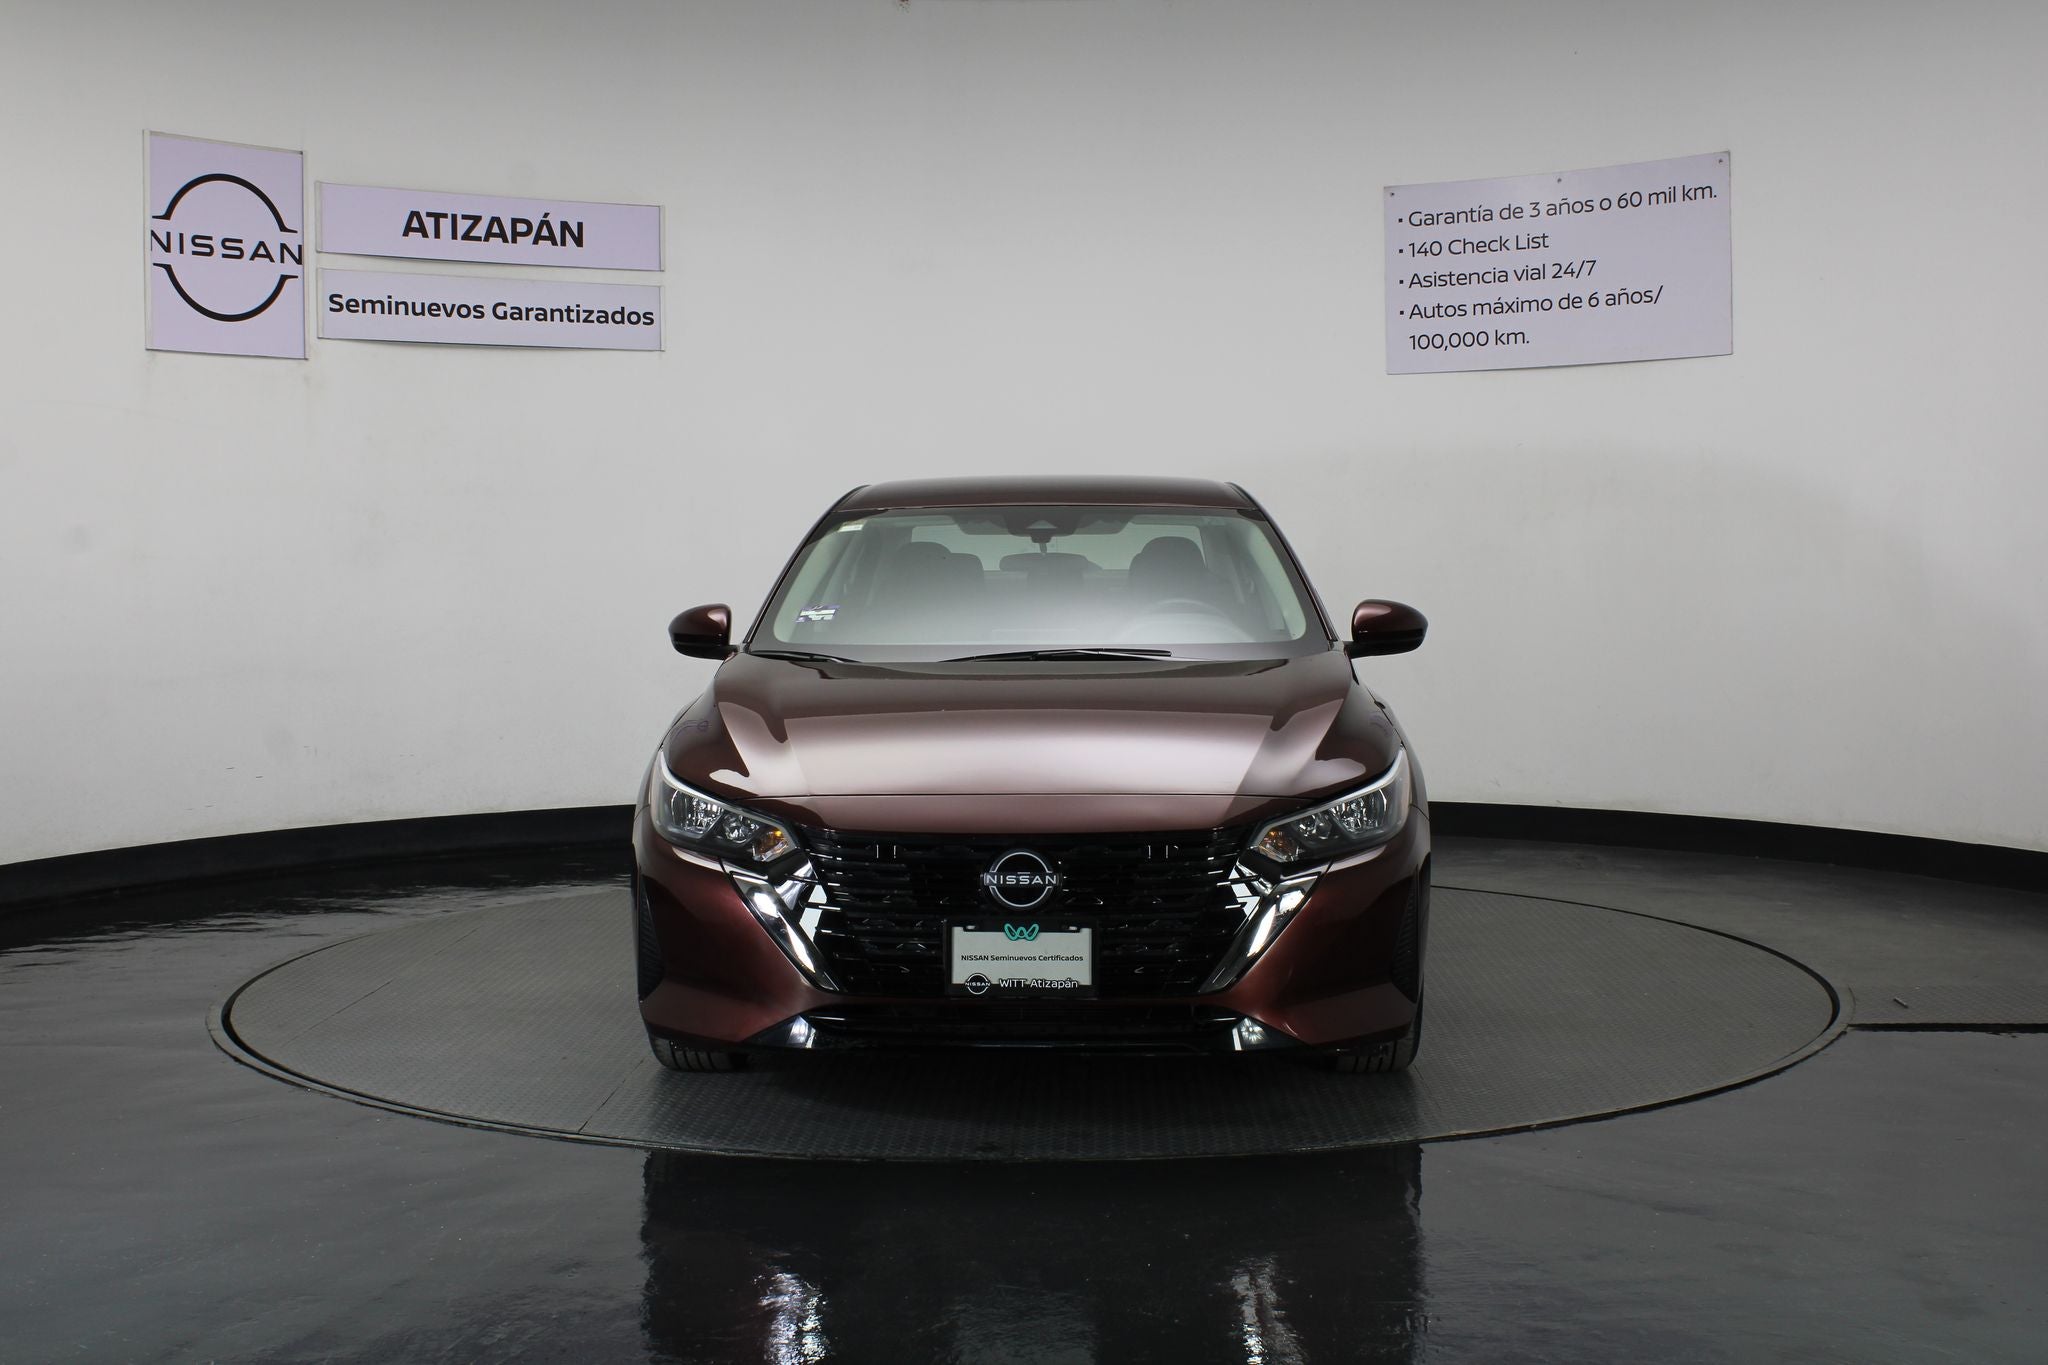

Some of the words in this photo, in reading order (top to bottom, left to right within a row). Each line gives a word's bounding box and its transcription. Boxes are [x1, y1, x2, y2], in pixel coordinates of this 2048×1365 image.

[1408, 204, 1494, 227] Garantía
[1499, 203, 1524, 221] de
[1529, 201, 1541, 218] 3
[1546, 197, 1595, 217] años
[1599, 197, 1612, 211] o
[1617, 190, 1643, 210] 60
[1648, 185, 1677, 206] mil
[1682, 184, 1718, 202] km.
[401, 211, 584, 248] ATIZAPÁN
[150, 229, 303, 265] NISSAN
[1408, 240, 1443, 258] 140
[1447, 234, 1511, 256] Check
[1515, 232, 1550, 251] List
[1408, 267, 1509, 289] Asistencia
[1513, 263, 1546, 282] vial
[1551, 259, 1597, 279] 24/7
[328, 293, 486, 320] Seminuevos
[491, 301, 655, 326] Garantizados
[1408, 302, 1468, 320] Autos
[1472, 296, 1553, 316] máximo
[1558, 292, 1583, 311] de
[1587, 291, 1600, 308] 6
[1605, 284, 1664, 308] años/
[1408, 330, 1490, 352] 100,000
[1494, 329, 1530, 346] km.
[986, 874, 1057, 885] NISSAN
[961, 954, 989, 962] NISSAN
[990, 954, 1037, 962] Seminuevos
[1038, 954, 1084, 962] Certificados
[999, 979, 1026, 988] WITT
[1030, 977, 1078, 989] Atizapán
